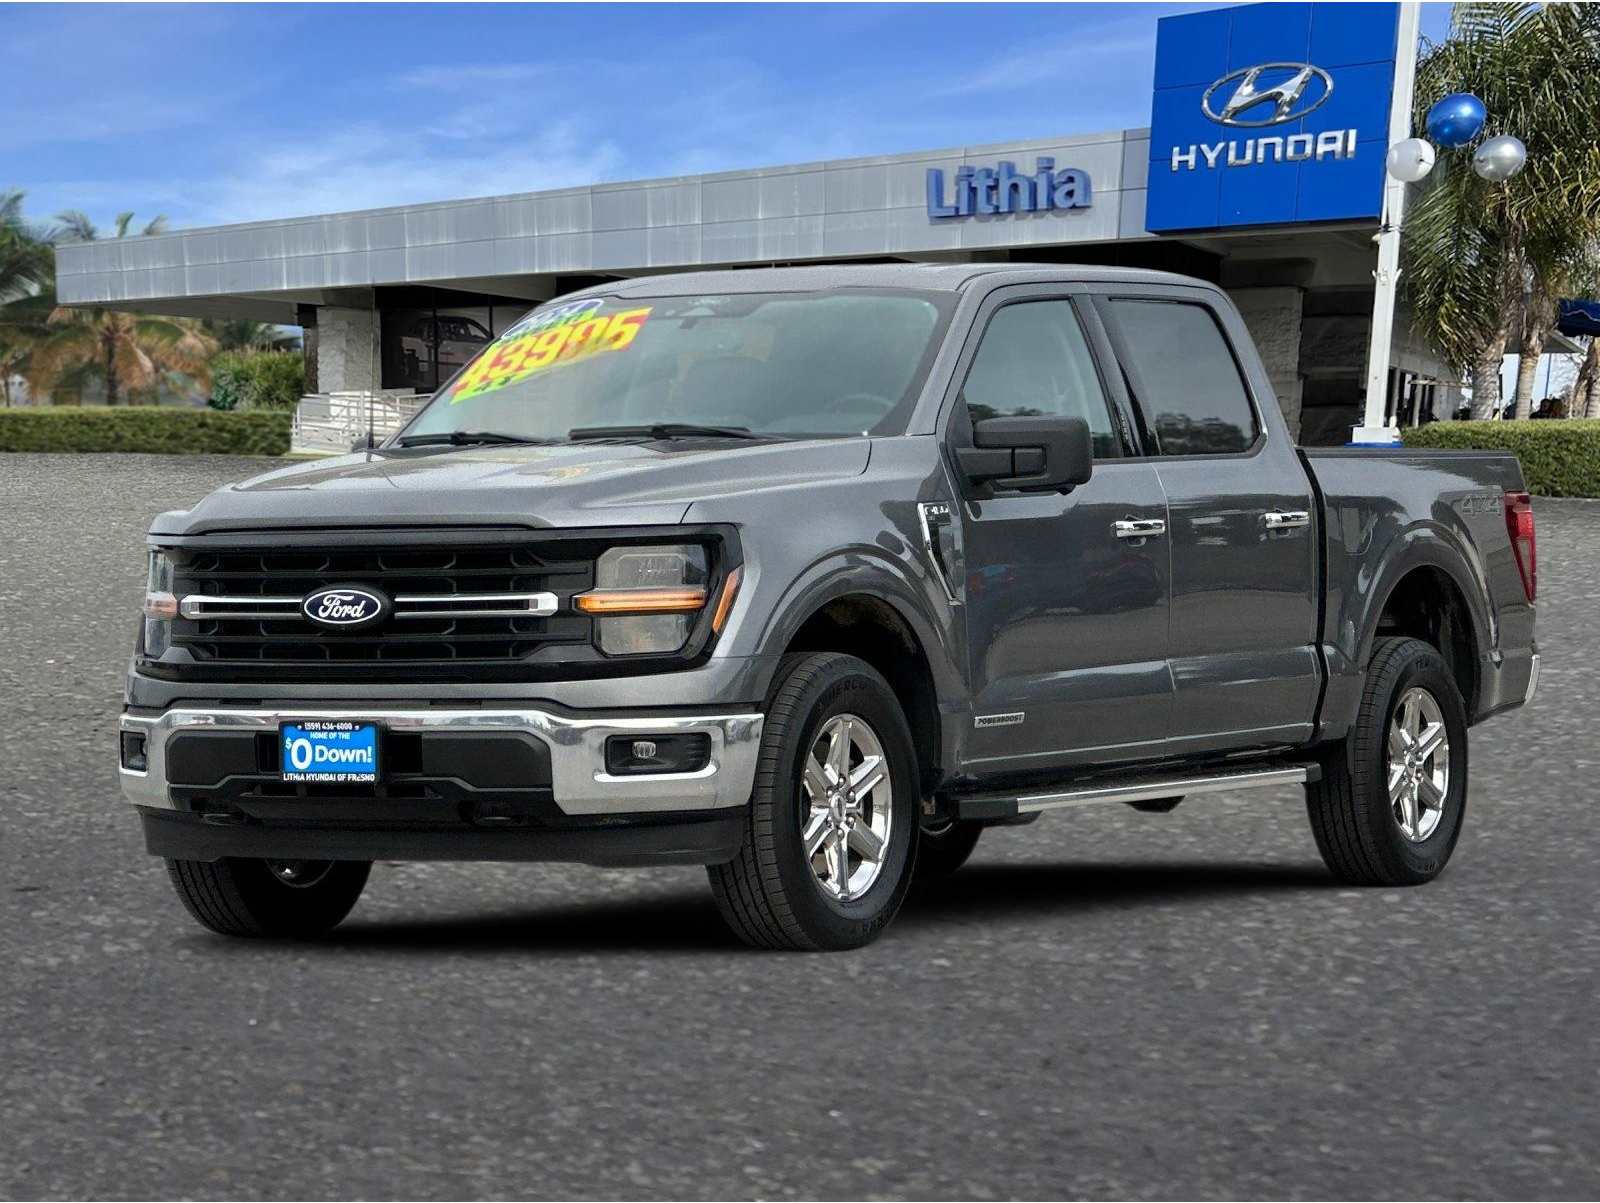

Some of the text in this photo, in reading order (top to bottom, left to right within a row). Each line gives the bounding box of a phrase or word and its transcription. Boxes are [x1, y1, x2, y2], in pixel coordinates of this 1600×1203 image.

[1170, 129, 1357, 171] HYUNDAI
[926, 156, 1093, 219] Lithia
[318, 594, 366, 618] Ford
[304, 722, 320, 731] (559)
[309, 731, 351, 740] HOME OF THE
[315, 745, 372, 763] Down!
[283, 773, 375, 781] LITHIA HYUNDAI OF FRESNO
